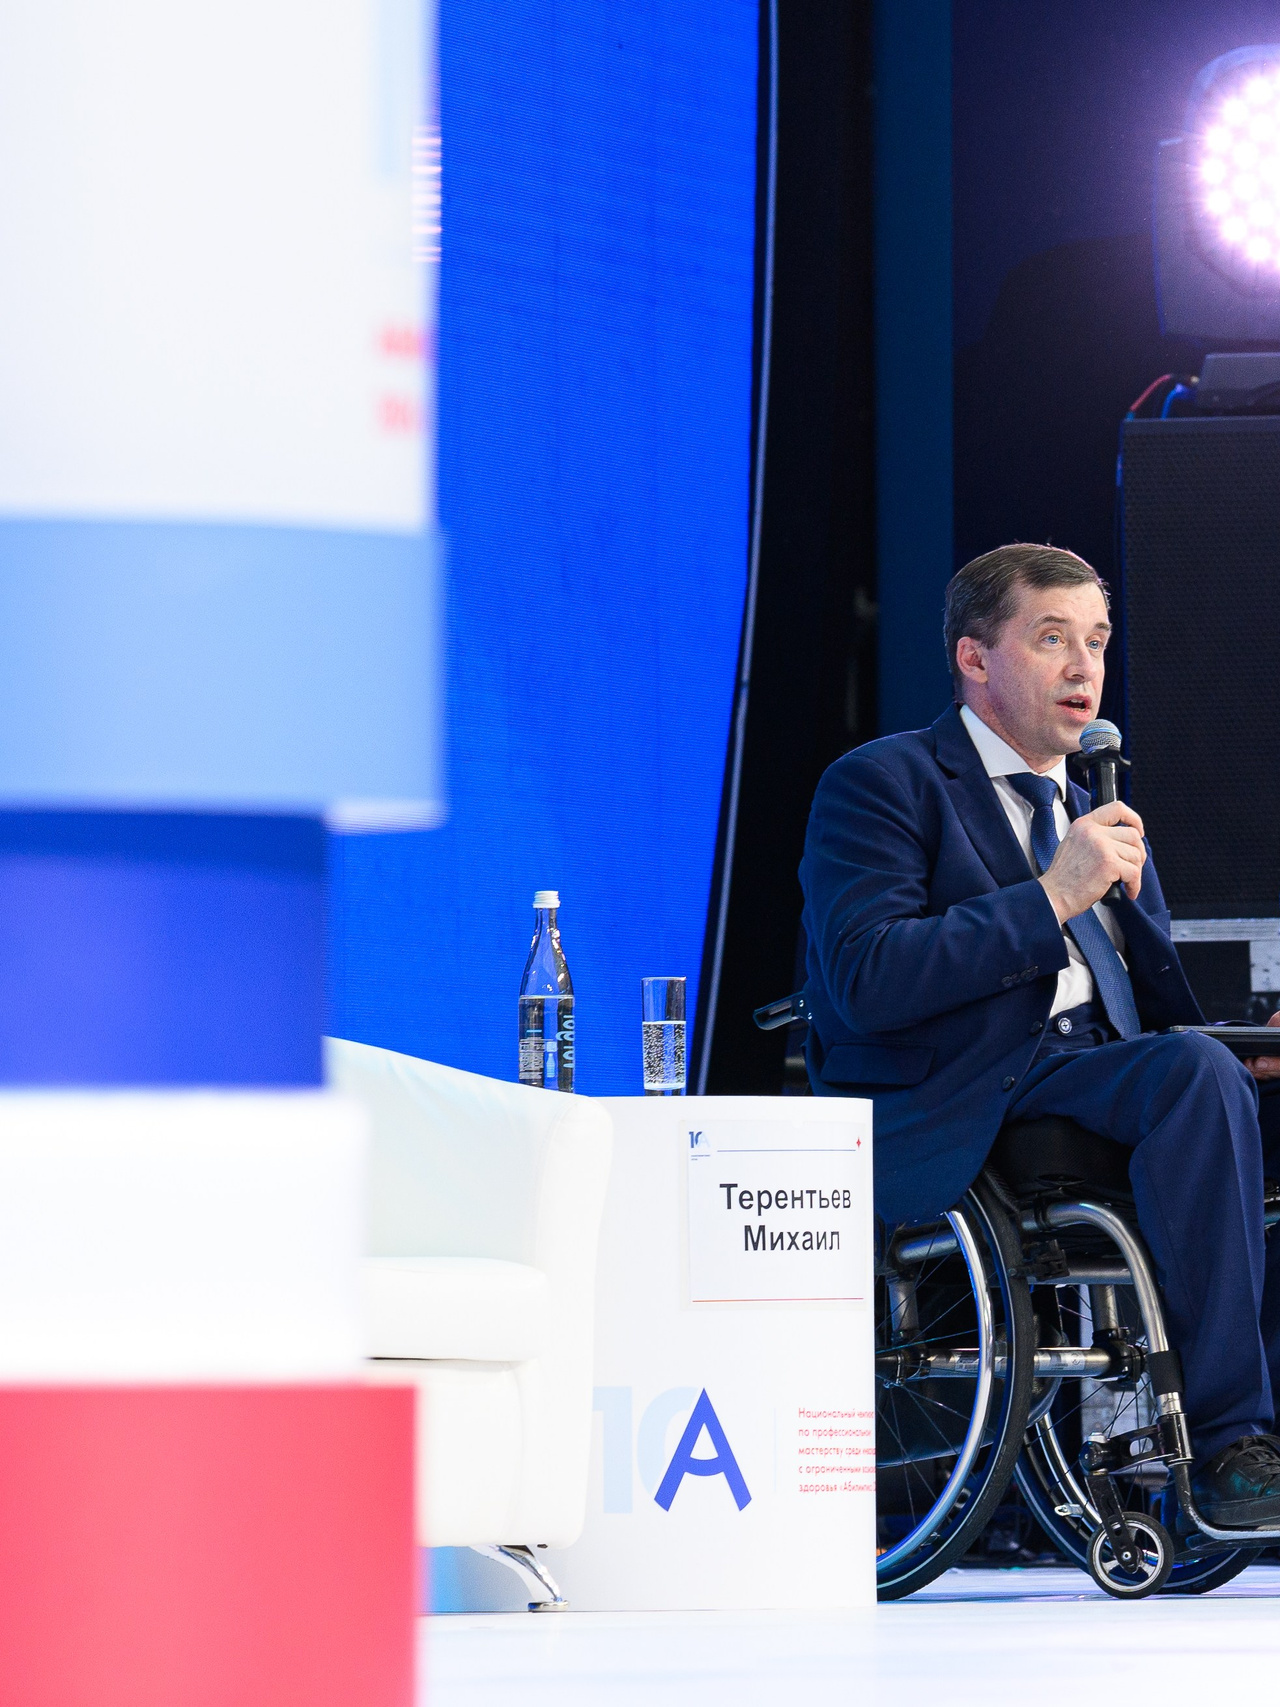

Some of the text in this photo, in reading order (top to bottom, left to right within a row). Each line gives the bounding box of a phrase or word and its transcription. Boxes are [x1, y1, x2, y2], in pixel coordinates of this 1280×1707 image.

[719, 1183, 852, 1216] Терентьев
[744, 1225, 841, 1252] Михаил
[798, 1429, 810, 1437] по
[798, 1447, 843, 1458] мастерству
[798, 1466, 803, 1474] с
[799, 1484, 838, 1495] здоровья
